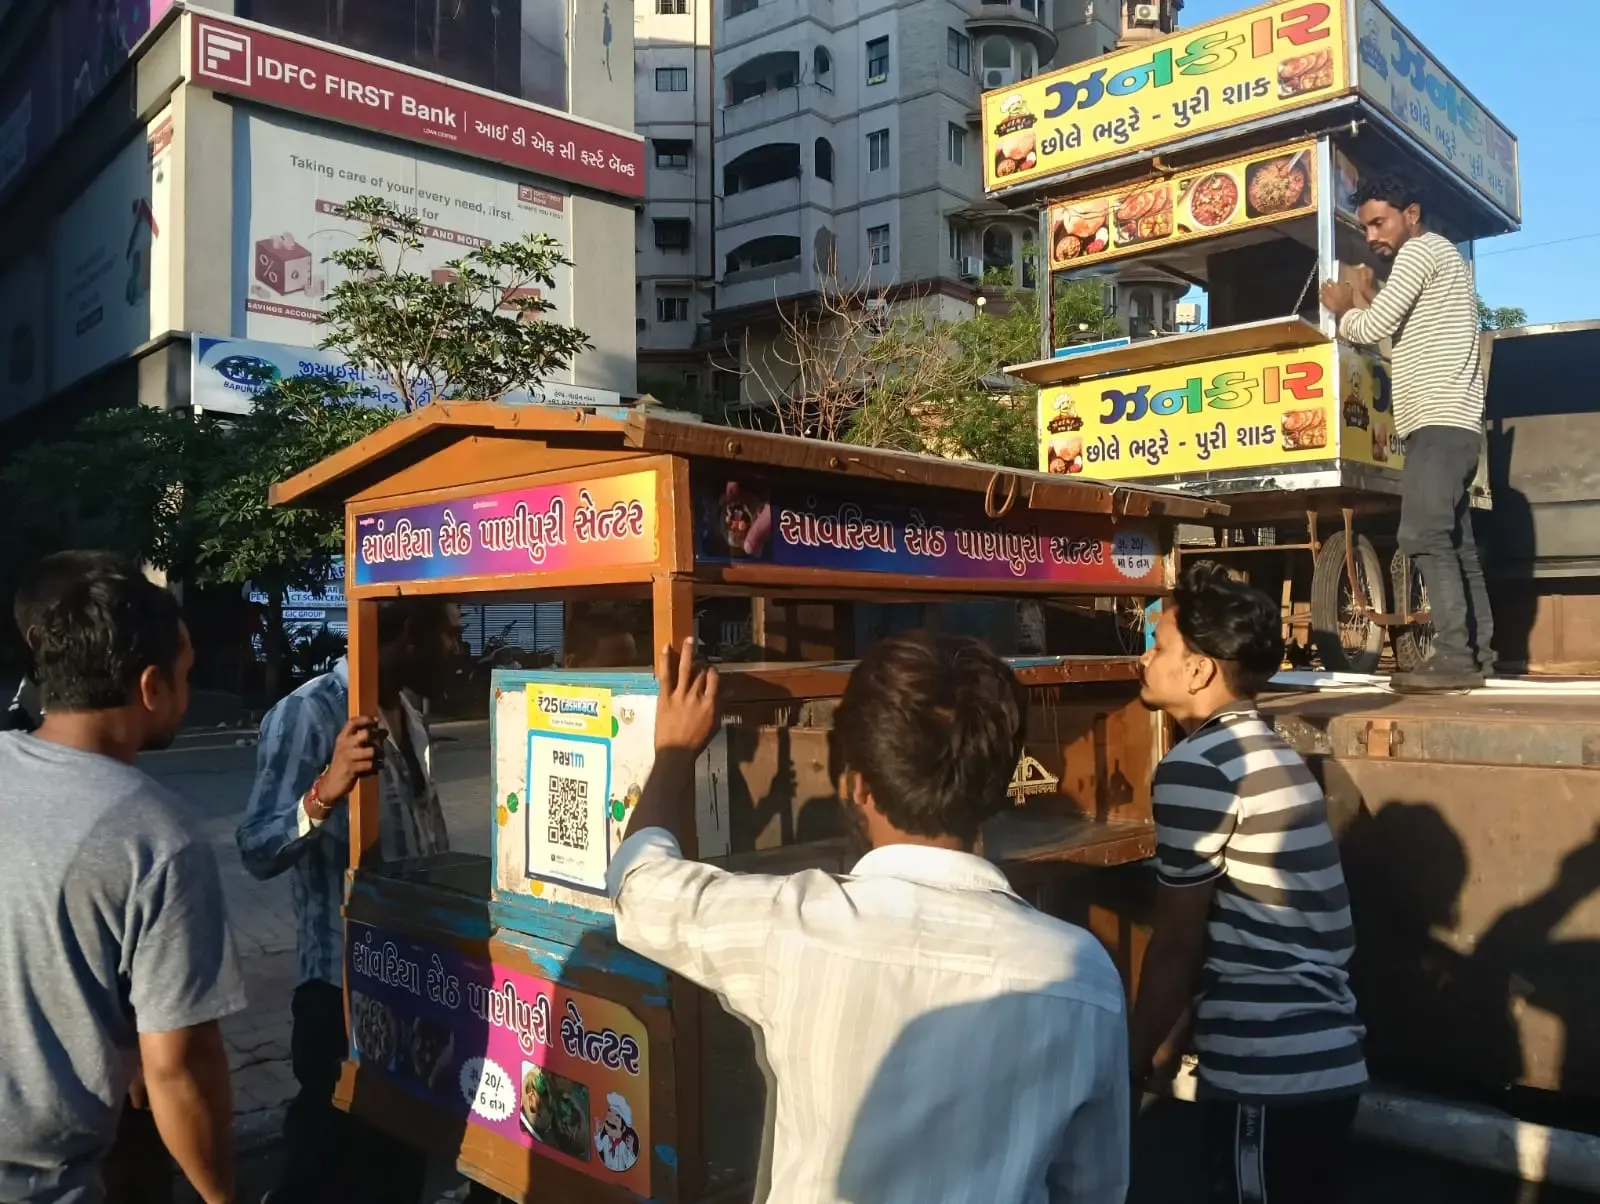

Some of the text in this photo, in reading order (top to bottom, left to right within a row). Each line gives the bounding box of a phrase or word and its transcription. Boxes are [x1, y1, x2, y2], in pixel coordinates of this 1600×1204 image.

[1044, 3, 1330, 120] ઝનકાર
[257, 55, 457, 128] IDFC FIRST Bank
[1391, 26, 1513, 176] ઝનકાર
[1041, 123, 1081, 156] છોલે
[1093, 106, 1140, 145] ભટુરે
[1172, 86, 1210, 128] પુરી
[1222, 76, 1272, 105] શાક
[475, 120, 509, 141] આઈ
[511, 127, 526, 147] ડી
[531, 132, 555, 156] એફ
[559, 141, 576, 161] સી
[290, 155, 334, 178] Taking
[339, 168, 367, 184] care
[371, 177, 384, 188] of
[387, 180, 415, 195] your
[418, 188, 450, 207] every
[455, 199, 486, 215] need,
[404, 205, 418, 216] us
[423, 208, 439, 221] for
[432, 228, 454, 241] AND
[457, 235, 487, 248] MORE
[247, 302, 318, 319] SAVINGS ACCOUN
[1099, 361, 1325, 425] ઝનકાર
[1086, 434, 1120, 463] છોલે
[1129, 428, 1169, 466] ભટુરે
[1195, 421, 1227, 461] પુરી
[1236, 424, 1277, 447] શાક
[362, 488, 645, 565] સાંવરિયા સેઠ પાણીપુરી સેન્ટર
[780, 495, 896, 553] સાંવરિયા
[1129, 556, 1134, 568] 6
[285, 610, 297, 618] GIC
[537, 695, 559, 714] ₹25
[353, 931, 640, 1075] સાંવરિયા સેઠ પાણીપુરી સેન્ટર
[480, 1091, 487, 1105] 6
[485, 1071, 505, 1093] 20/-
